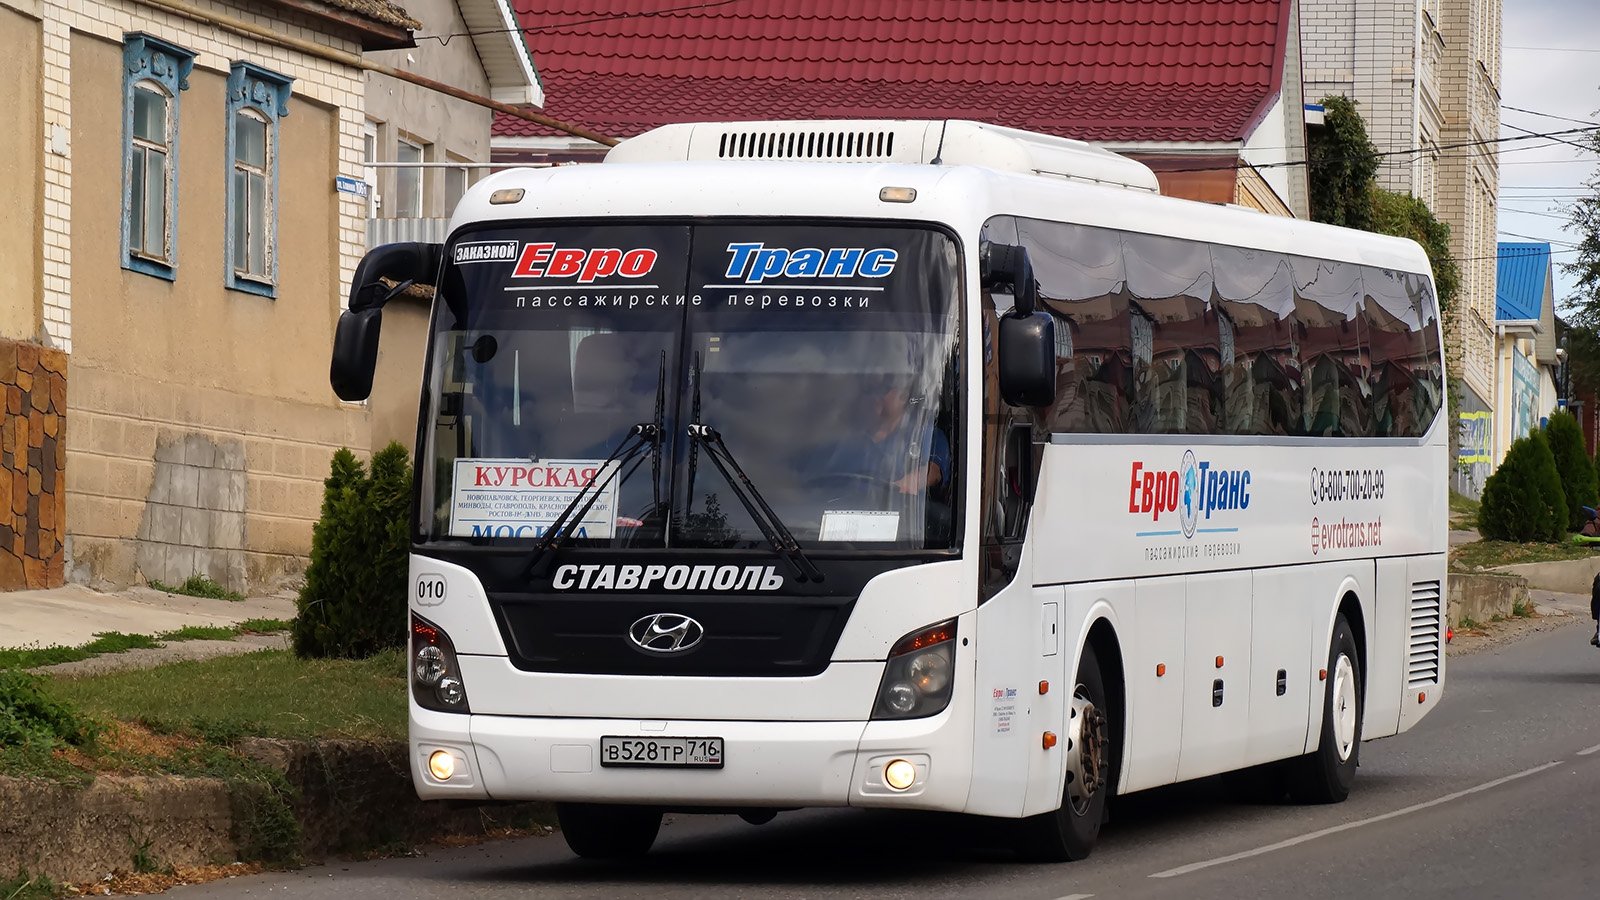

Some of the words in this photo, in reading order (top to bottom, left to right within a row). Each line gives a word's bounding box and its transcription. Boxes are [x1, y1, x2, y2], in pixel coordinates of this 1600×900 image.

[456, 243, 516, 261] ЗАКАЗНОЙ
[511, 242, 658, 283] Евро
[725, 242, 899, 284] Транс
[516, 294, 702, 309] пассажирские
[728, 294, 869, 308] перевозки
[474, 466, 598, 487] КУРСКАЯ
[1320, 469, 1385, 502] 8-800-700-20-99
[1129, 461, 1179, 521] Евро
[1198, 461, 1251, 519] Транс
[1321, 515, 1382, 550] evrotrans.net
[1203, 543, 1241, 560] перевозки
[552, 564, 784, 591] СТАВРОПОЛЬ
[418, 578, 445, 599] 010
[608, 740, 684, 761] В528ТР
[687, 741, 717, 756] 716
